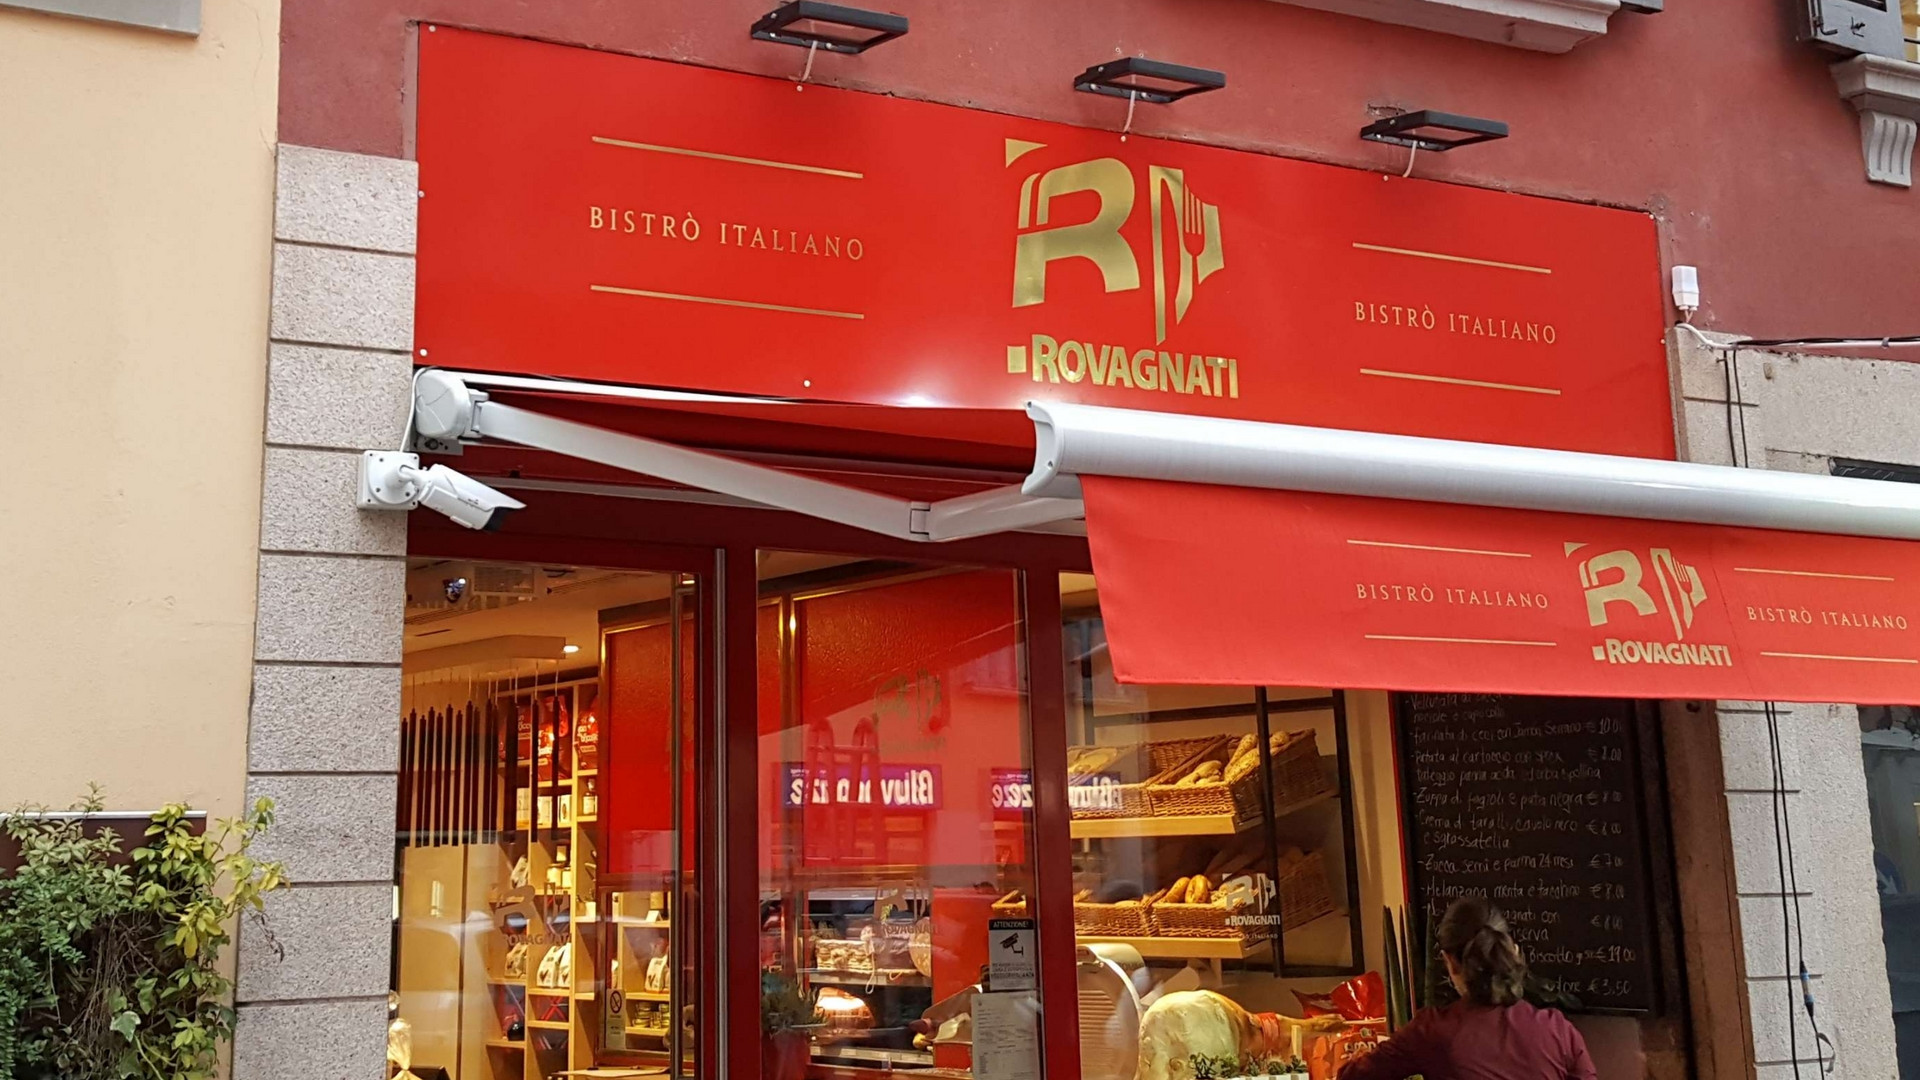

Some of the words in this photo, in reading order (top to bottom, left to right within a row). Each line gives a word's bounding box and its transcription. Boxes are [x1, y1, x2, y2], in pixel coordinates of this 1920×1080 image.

[589, 206, 700, 241] BISTRÒ
[720, 221, 864, 261] ITALIANO
[1354, 301, 1435, 330] BISTRÒ
[1449, 313, 1557, 345] ITALIANO
[1032, 333, 1240, 400] ROVAGNATI
[1356, 582, 1434, 604] BISTRÒ
[1446, 588, 1549, 609] ITALIANO
[1746, 605, 1813, 624] BISTRÒ
[1821, 611, 1909, 631] ITALIANO
[1605, 637, 1733, 667] ROVAGNATI
[1230, 914, 1281, 927] ROVAGNATI
